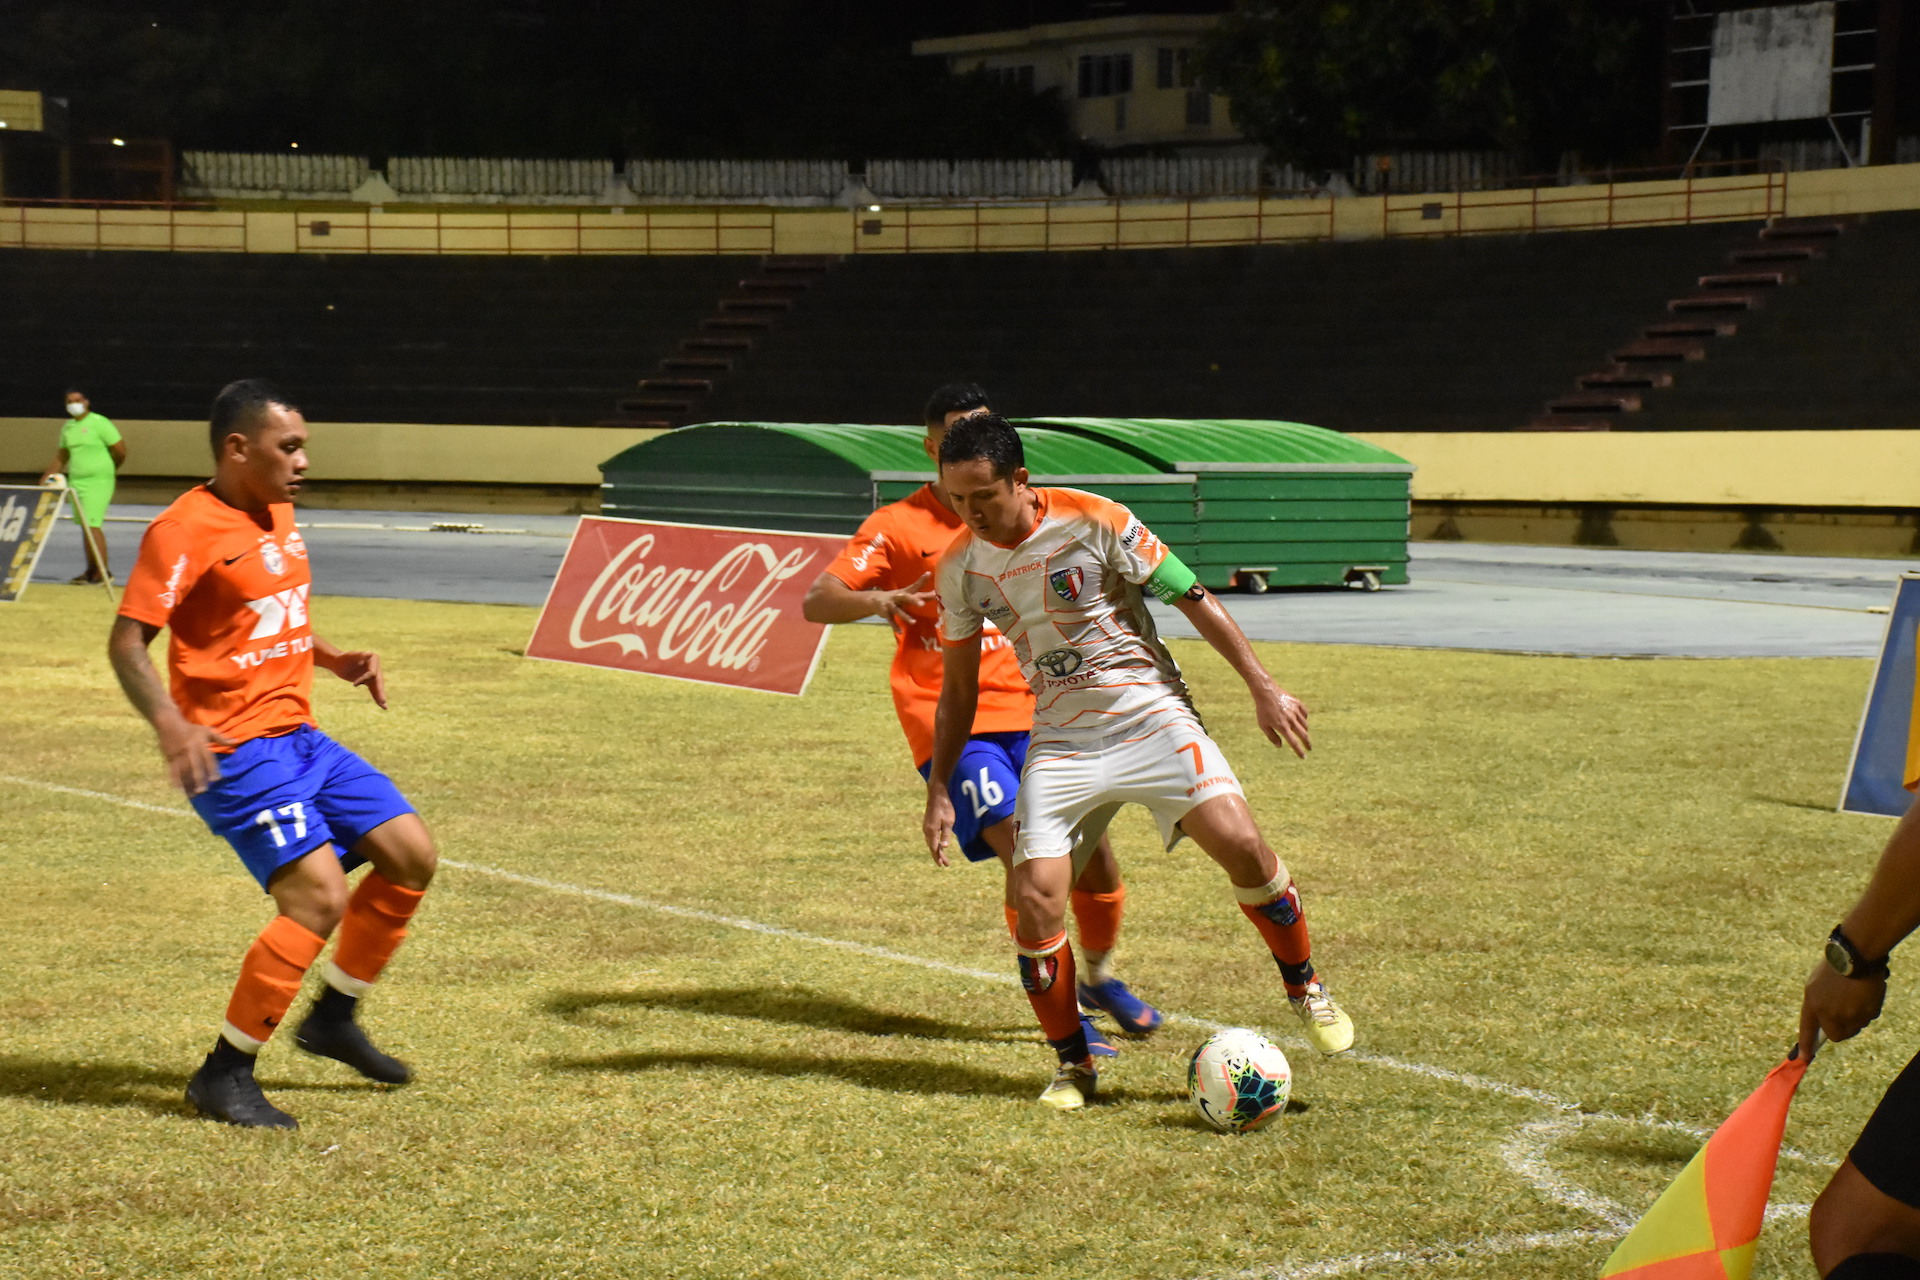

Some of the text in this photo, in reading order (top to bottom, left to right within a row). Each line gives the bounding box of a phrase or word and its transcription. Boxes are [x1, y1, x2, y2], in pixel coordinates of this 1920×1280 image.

[1007, 561, 1044, 579] PATRICK
[568, 533, 819, 671] Coca-Cola
[1046, 670, 1097, 688] TOYOTA
[1175, 741, 1205, 775] 7
[960, 766, 1005, 819] 26
[254, 801, 307, 847] 17
